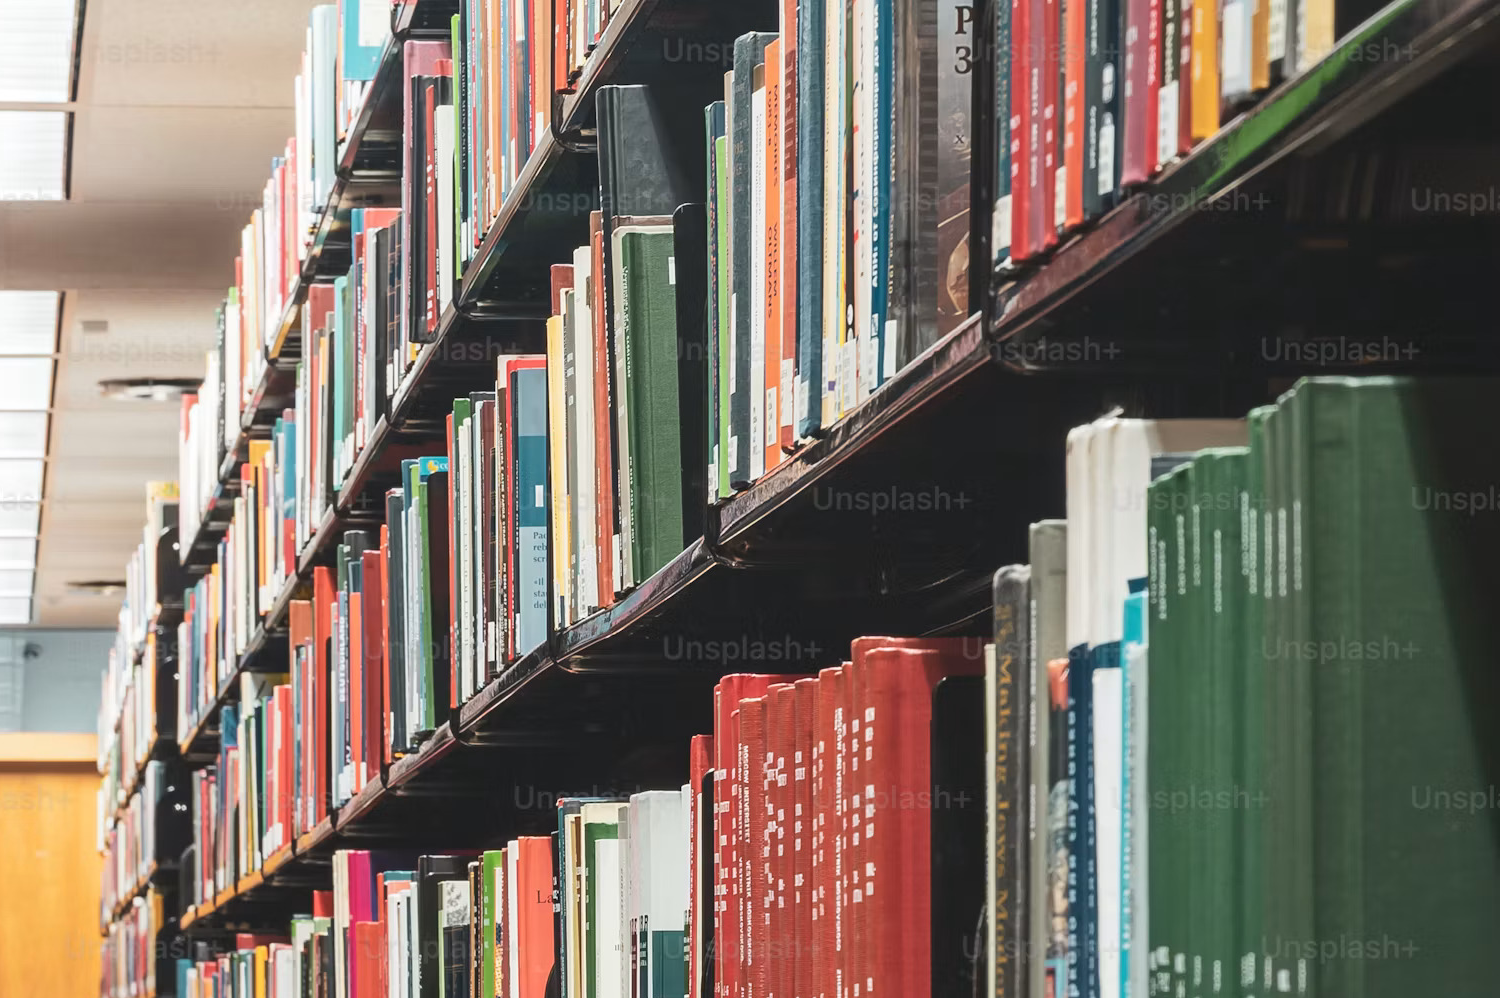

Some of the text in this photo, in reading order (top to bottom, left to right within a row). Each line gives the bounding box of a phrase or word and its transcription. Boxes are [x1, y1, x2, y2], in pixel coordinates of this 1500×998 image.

[997, 656, 1011, 784] Making
[743, 786, 751, 844] UNIVERSITET
[997, 794, 1010, 877] Jews
